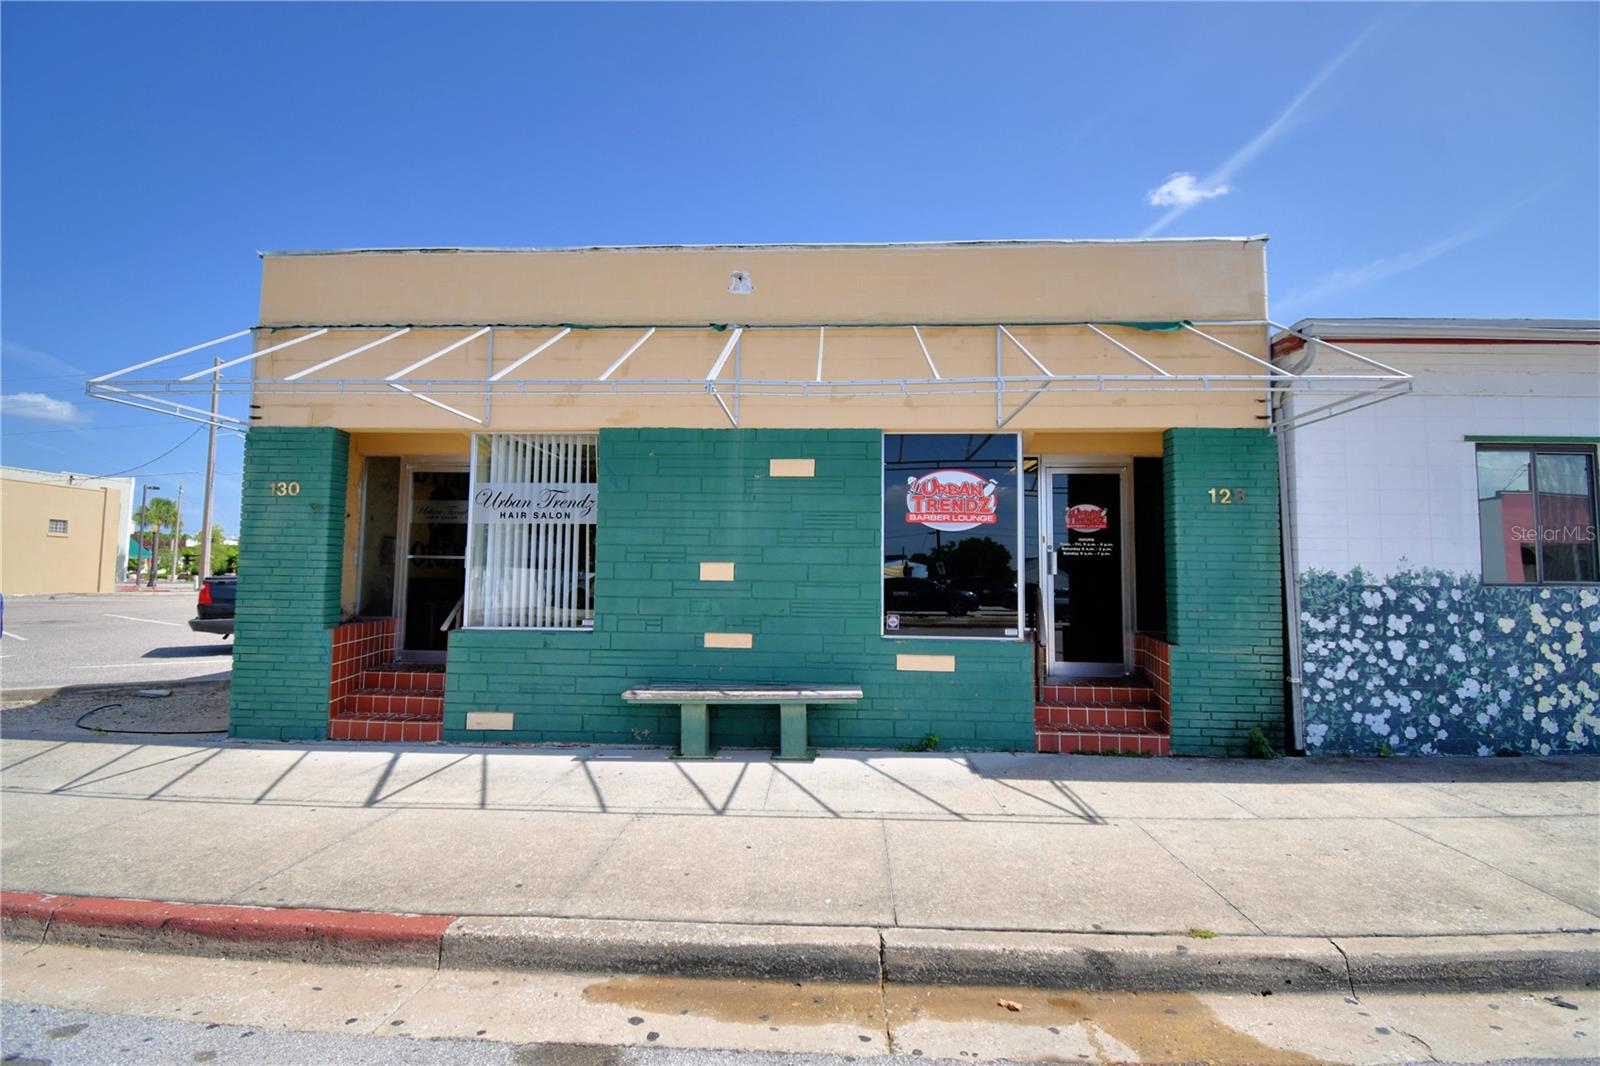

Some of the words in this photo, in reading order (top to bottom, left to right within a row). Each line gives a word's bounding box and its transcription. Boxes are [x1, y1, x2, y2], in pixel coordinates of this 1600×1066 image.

[269, 481, 301, 497] 130
[920, 476, 984, 497] URBAN
[475, 488, 532, 510] Urban
[536, 488, 596, 518] Trendz
[912, 494, 993, 513] TRENDZ
[909, 514, 950, 522] BARBER
[952, 514, 994, 522] LOUNGE
